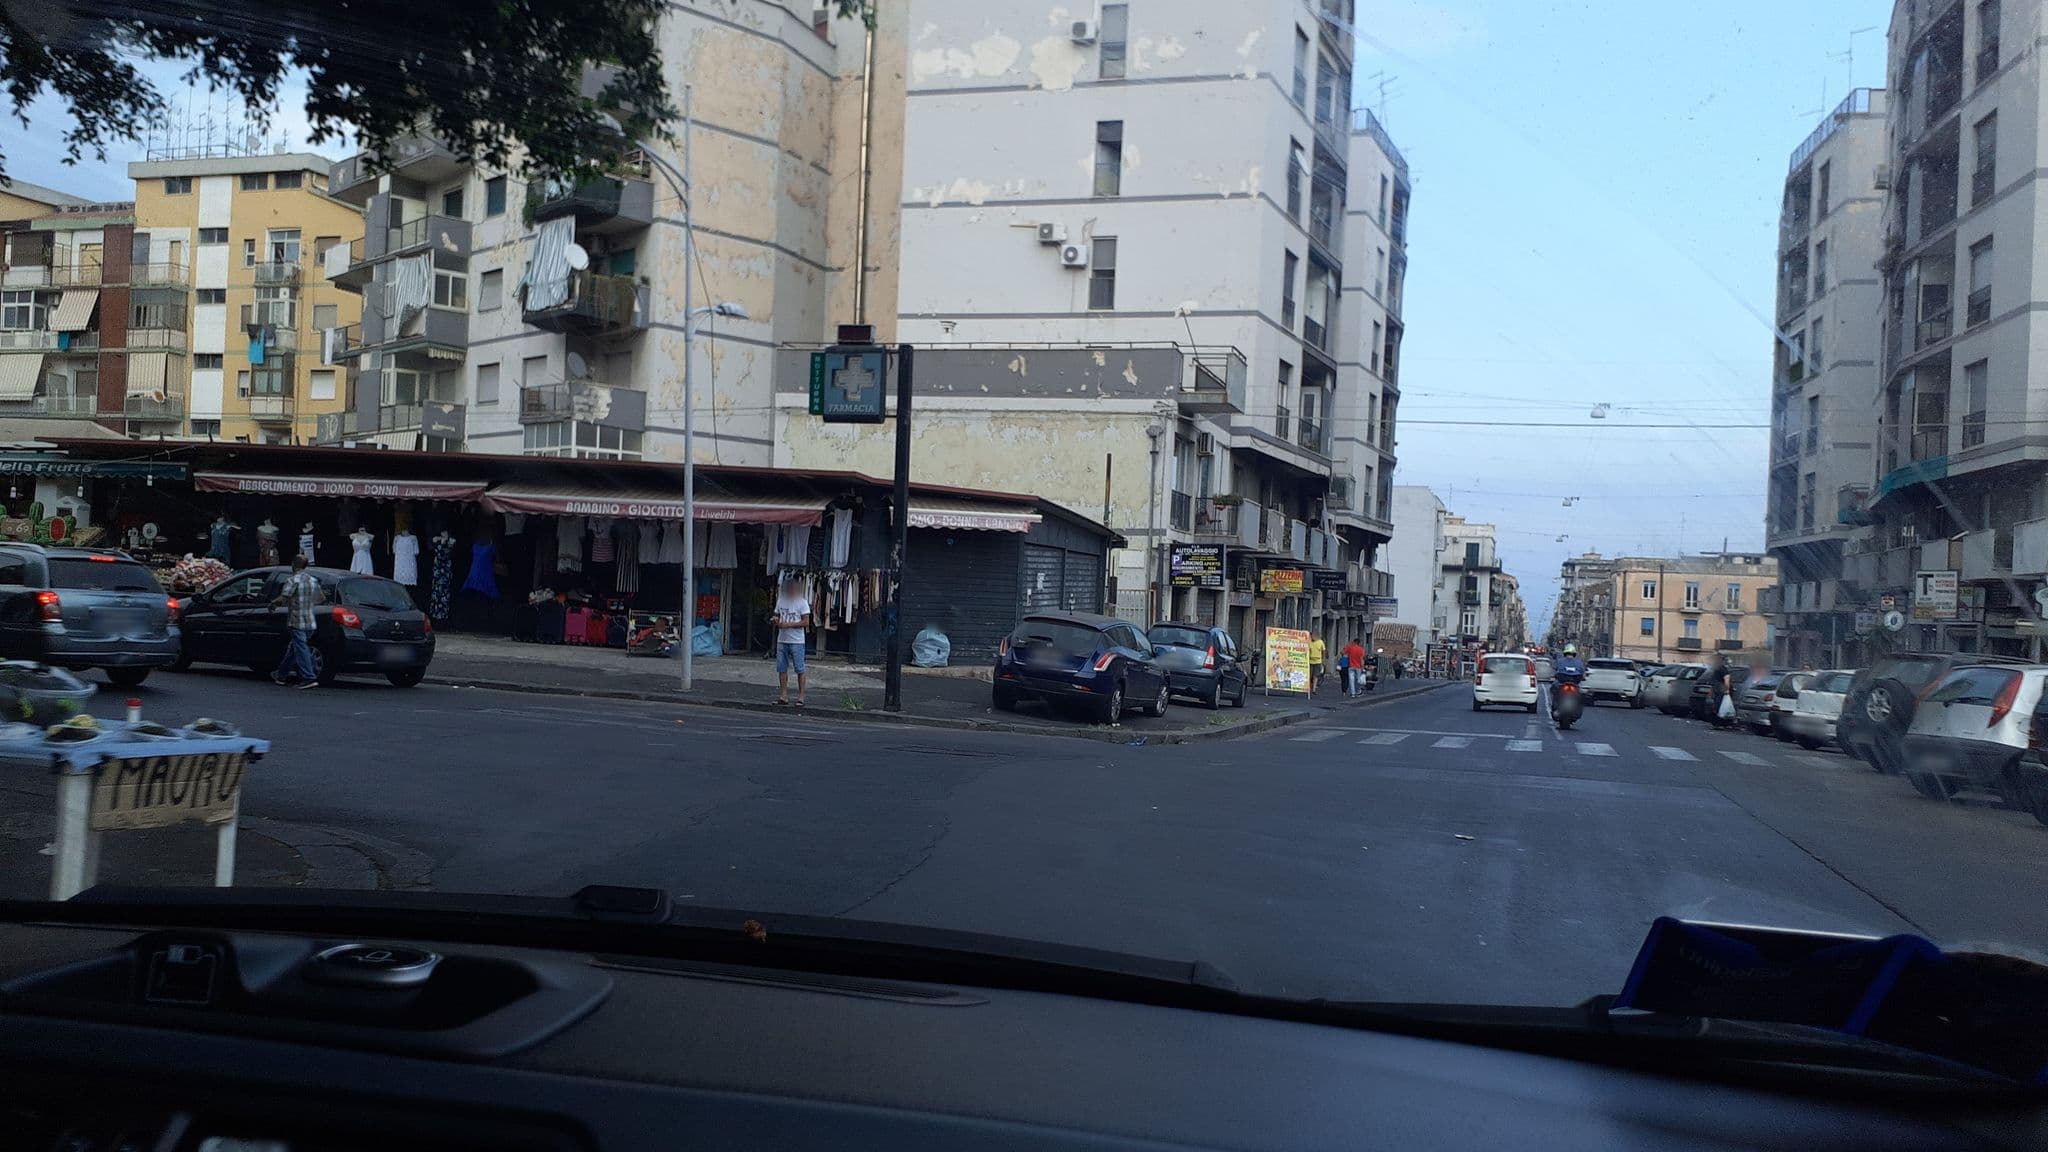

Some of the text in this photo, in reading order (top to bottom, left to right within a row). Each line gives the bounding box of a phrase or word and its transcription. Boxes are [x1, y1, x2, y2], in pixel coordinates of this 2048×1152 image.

[829, 404, 875, 412] FARMACIA
[0, 462, 32, 471] ella
[238, 480, 317, 493] ABBIGLIAMENTO
[324, 483, 353, 494] UOMO
[364, 485, 398, 496] DONNA
[566, 502, 620, 515] BAMBINO
[628, 504, 685, 517] GIOCATTO
[910, 514, 935, 525] OMO
